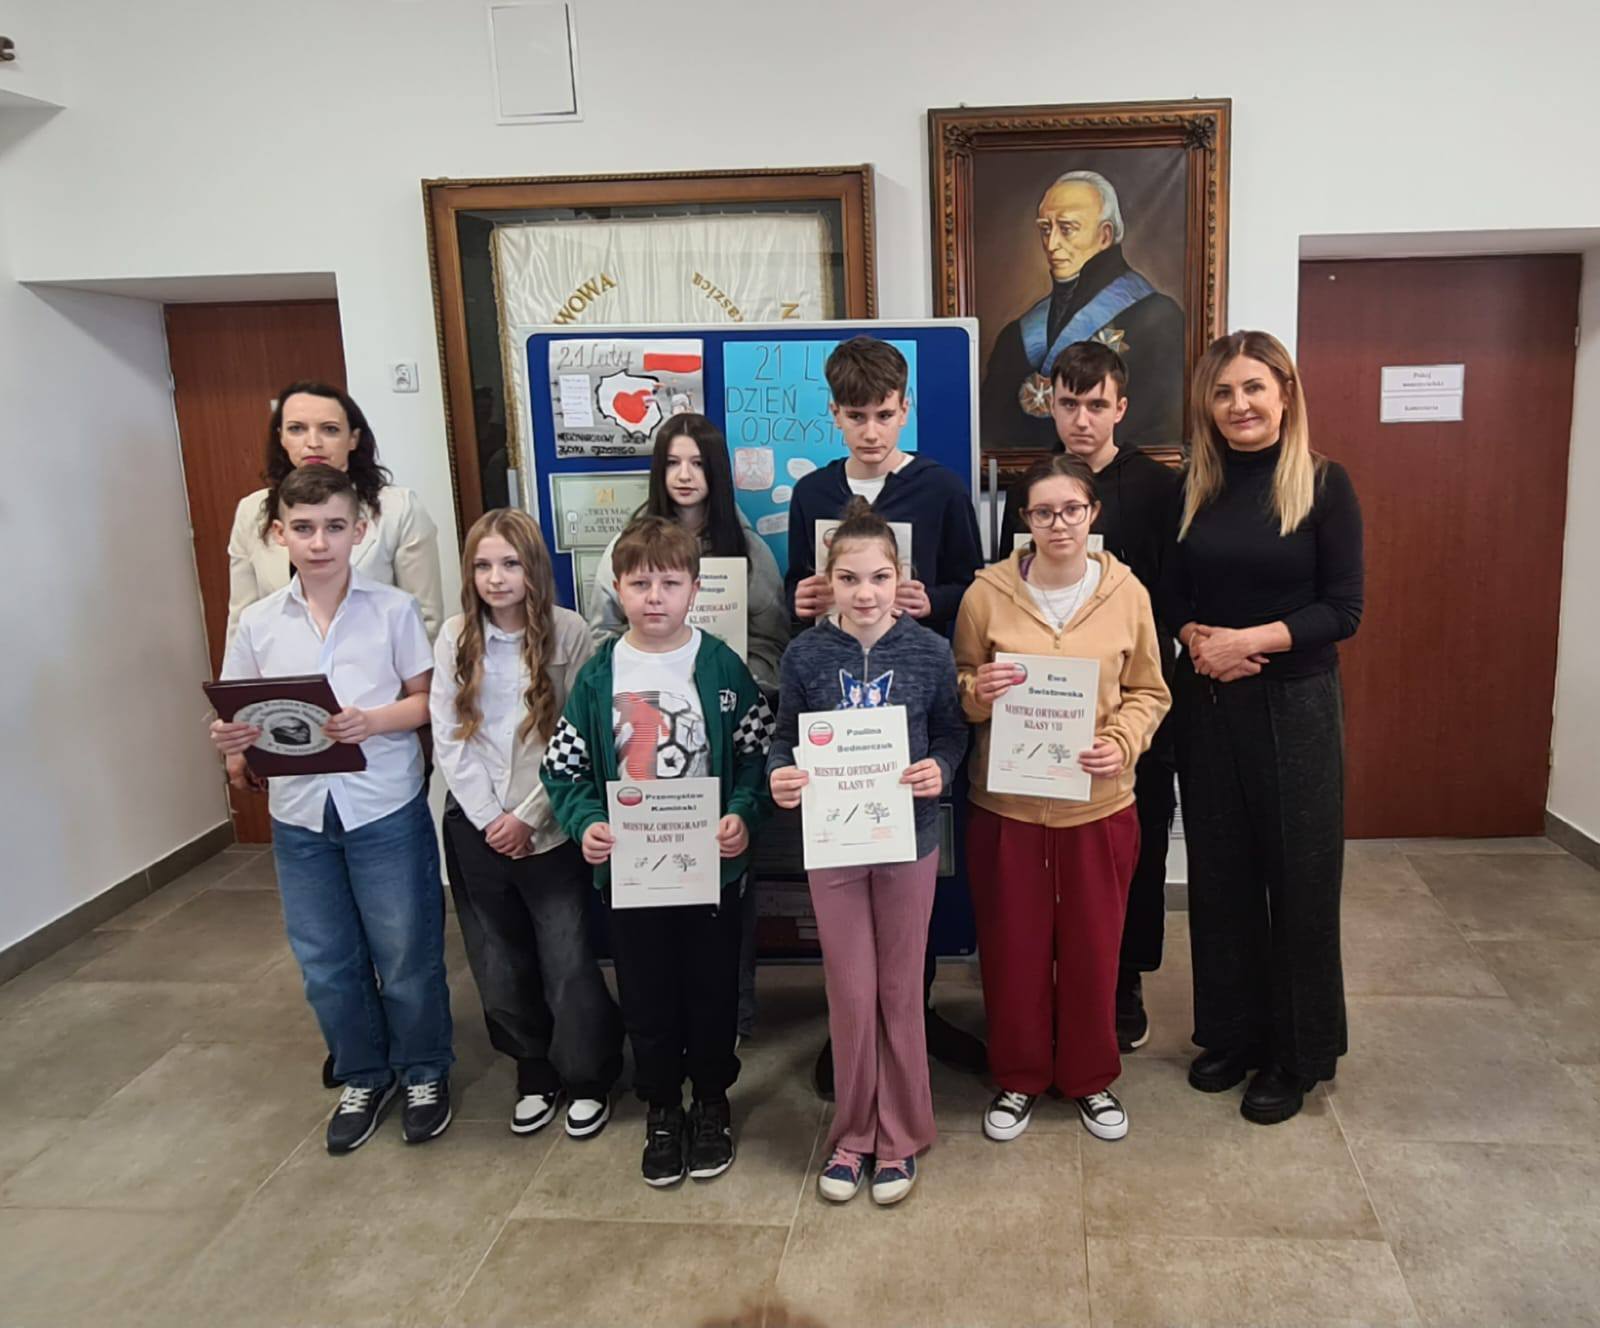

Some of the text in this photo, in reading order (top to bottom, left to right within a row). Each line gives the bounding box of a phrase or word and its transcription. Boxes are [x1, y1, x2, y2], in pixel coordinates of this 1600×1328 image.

[557, 345, 584, 371] 21
[755, 344, 782, 381] 21
[726, 384, 797, 415] DZIEŃ
[1047, 673, 1068, 683] Ewa
[1024, 720, 1048, 730] KLASY
[814, 761, 897, 777] MISTRZ ORTOGRAFII
[838, 778, 877, 791] KLASY IV
[622, 820, 708, 832] MISTRZ ORTOGRAFII
[646, 833, 685, 843] KLASY III
